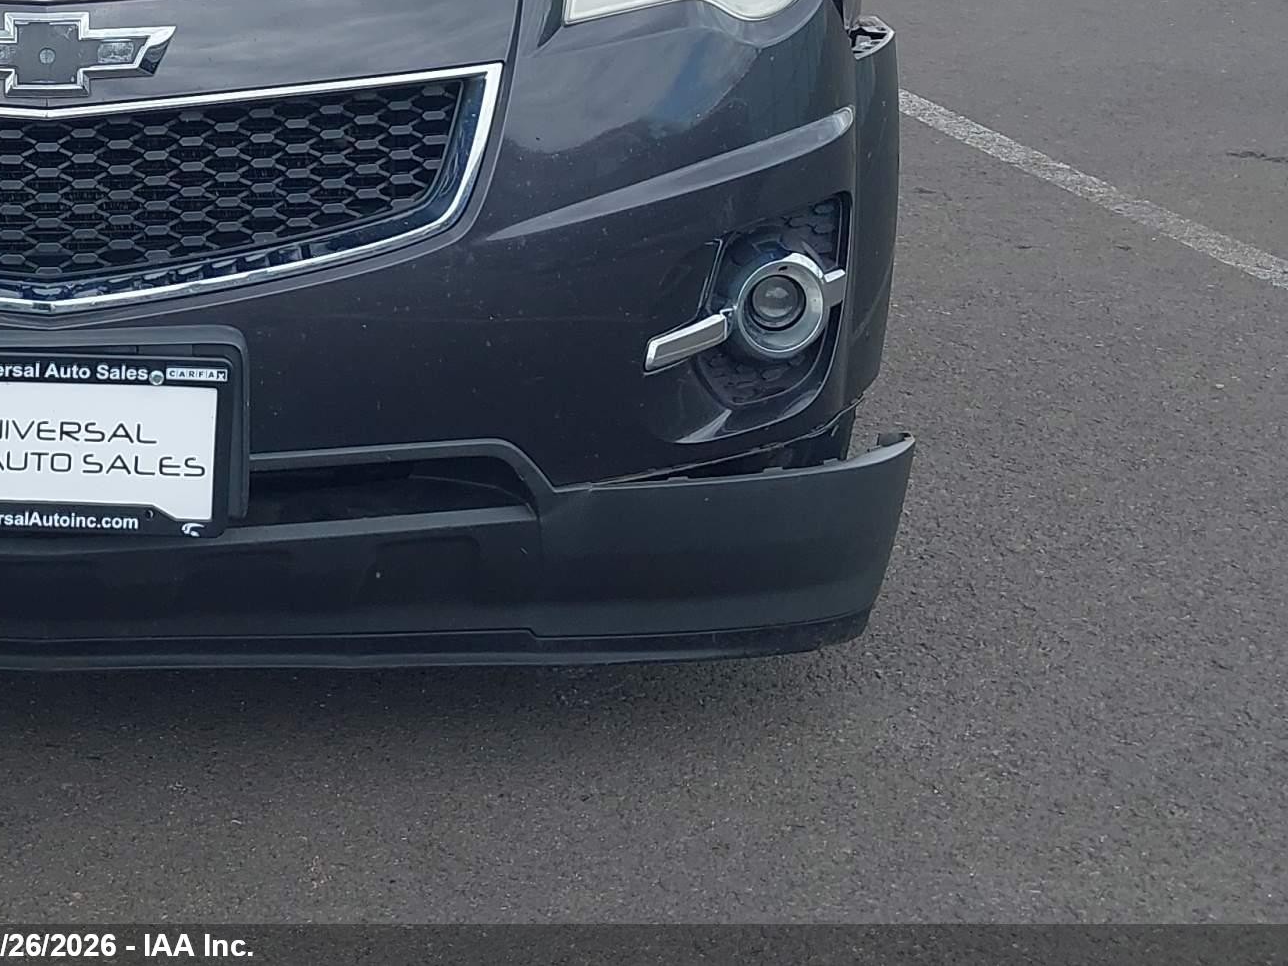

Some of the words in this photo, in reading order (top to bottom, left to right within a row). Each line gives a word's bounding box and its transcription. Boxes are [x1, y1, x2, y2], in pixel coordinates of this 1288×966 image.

[44, 363, 92, 379] Auto
[96, 365, 149, 381] Sales
[168, 369, 227, 381] CARFAX
[82, 452, 207, 478] SALES
